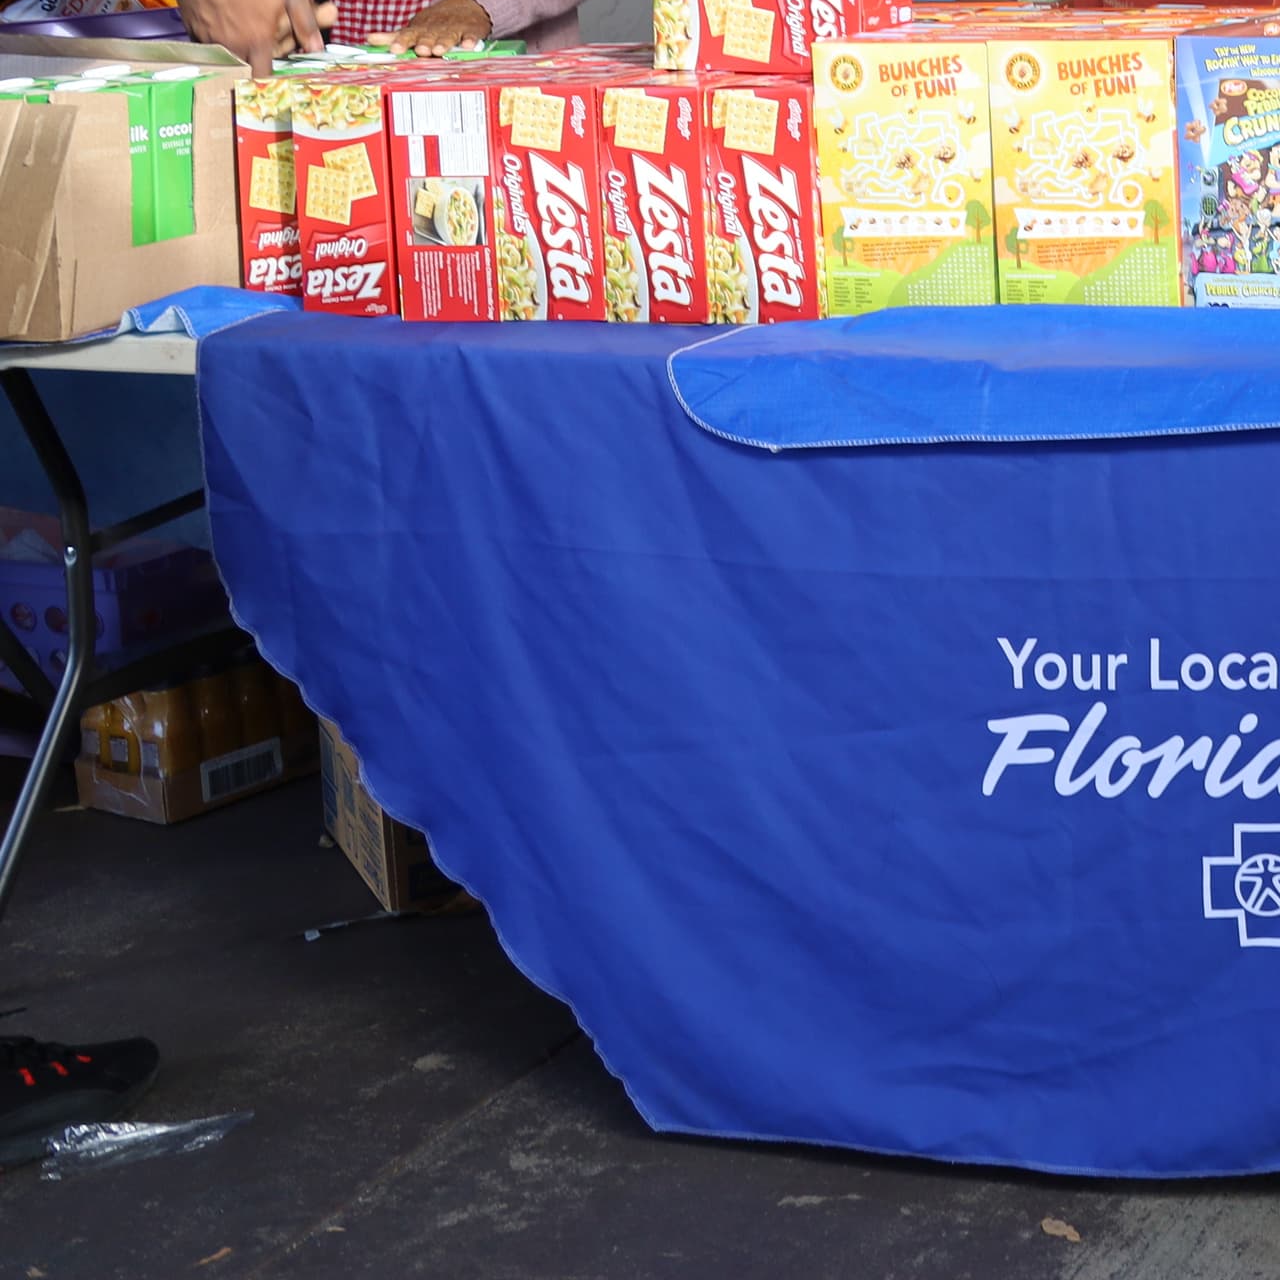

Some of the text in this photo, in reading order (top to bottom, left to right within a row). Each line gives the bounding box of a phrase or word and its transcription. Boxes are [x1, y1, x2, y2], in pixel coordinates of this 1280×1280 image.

[878, 54, 963, 83] BUNCHES
[1057, 52, 1143, 81] BUNCHES
[1215, 45, 1256, 57] TRY NEW
[1241, 55, 1260, 66] WAY
[891, 77, 957, 100] OF FUN!
[1070, 74, 1137, 98] OF FUN!
[501, 153, 528, 234] Originales
[606, 169, 633, 236] Original
[716, 172, 742, 238] Original
[528, 151, 593, 308] Zesta
[631, 153, 695, 308] Zesta
[740, 153, 806, 309] Zesta
[314, 237, 367, 262] Original
[306, 262, 387, 299] Zesta
[996, 636, 1129, 691] Your
